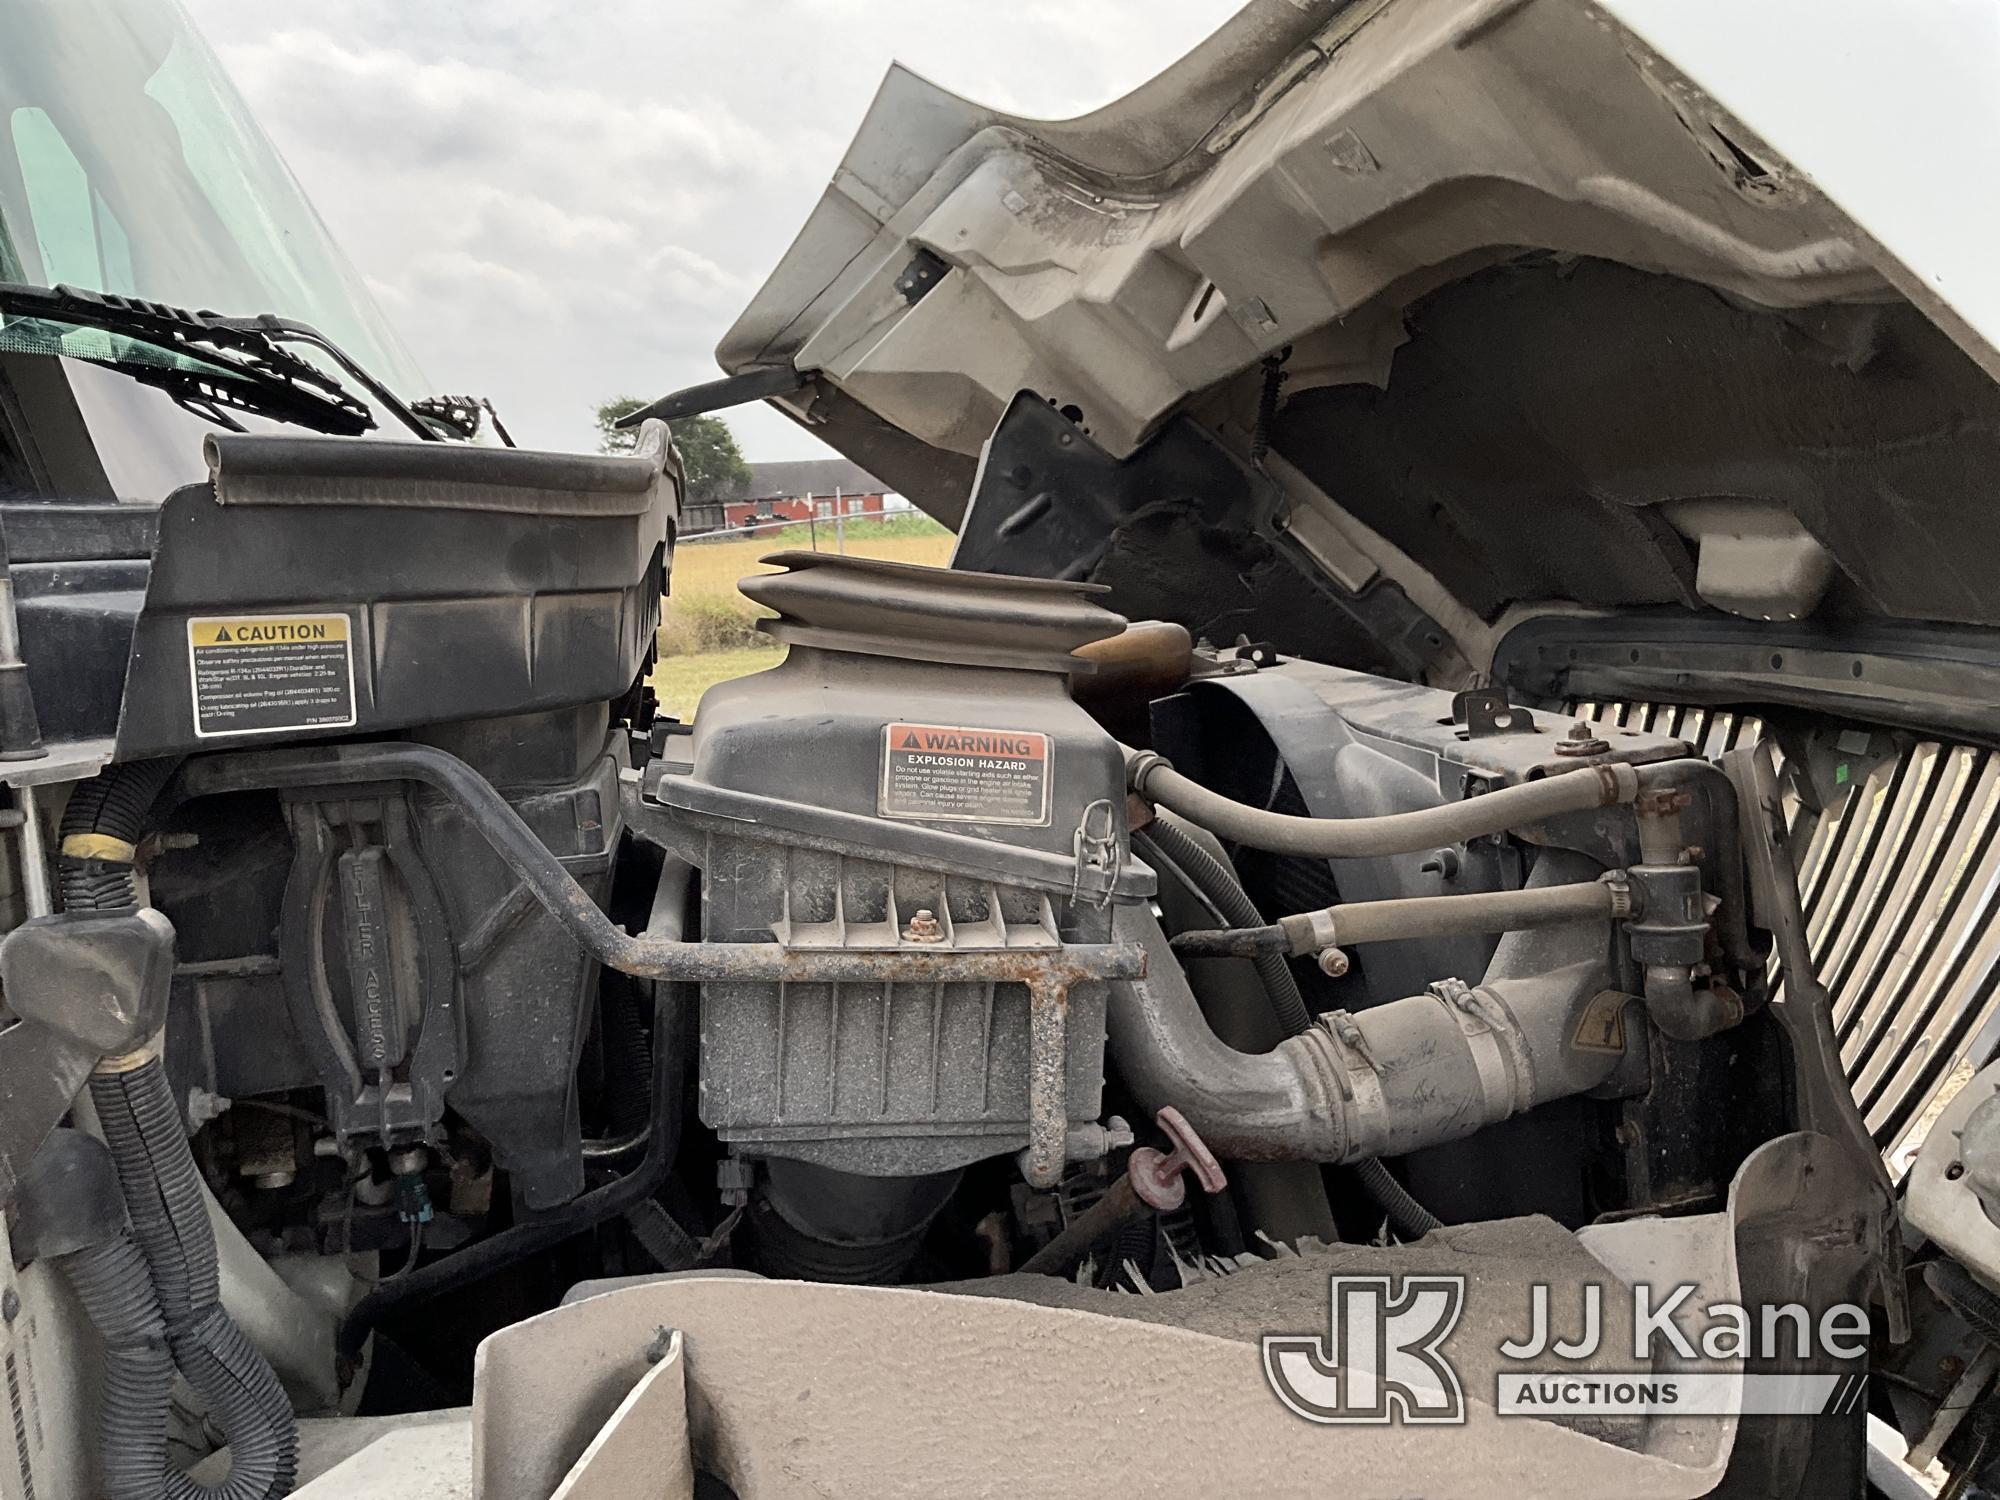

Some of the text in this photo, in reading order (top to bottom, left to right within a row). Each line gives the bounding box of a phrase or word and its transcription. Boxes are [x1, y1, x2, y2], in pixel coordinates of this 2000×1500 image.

[237, 624, 325, 641] CAUTION
[925, 732, 1031, 756] WARNING
[908, 754, 1027, 770] EXPLOSION HAZARD
[896, 774, 922, 782] propane
[956, 770, 980, 778] starting
[938, 800, 956, 808] injury
[351, 863, 386, 1059] FILTER ACCESS
